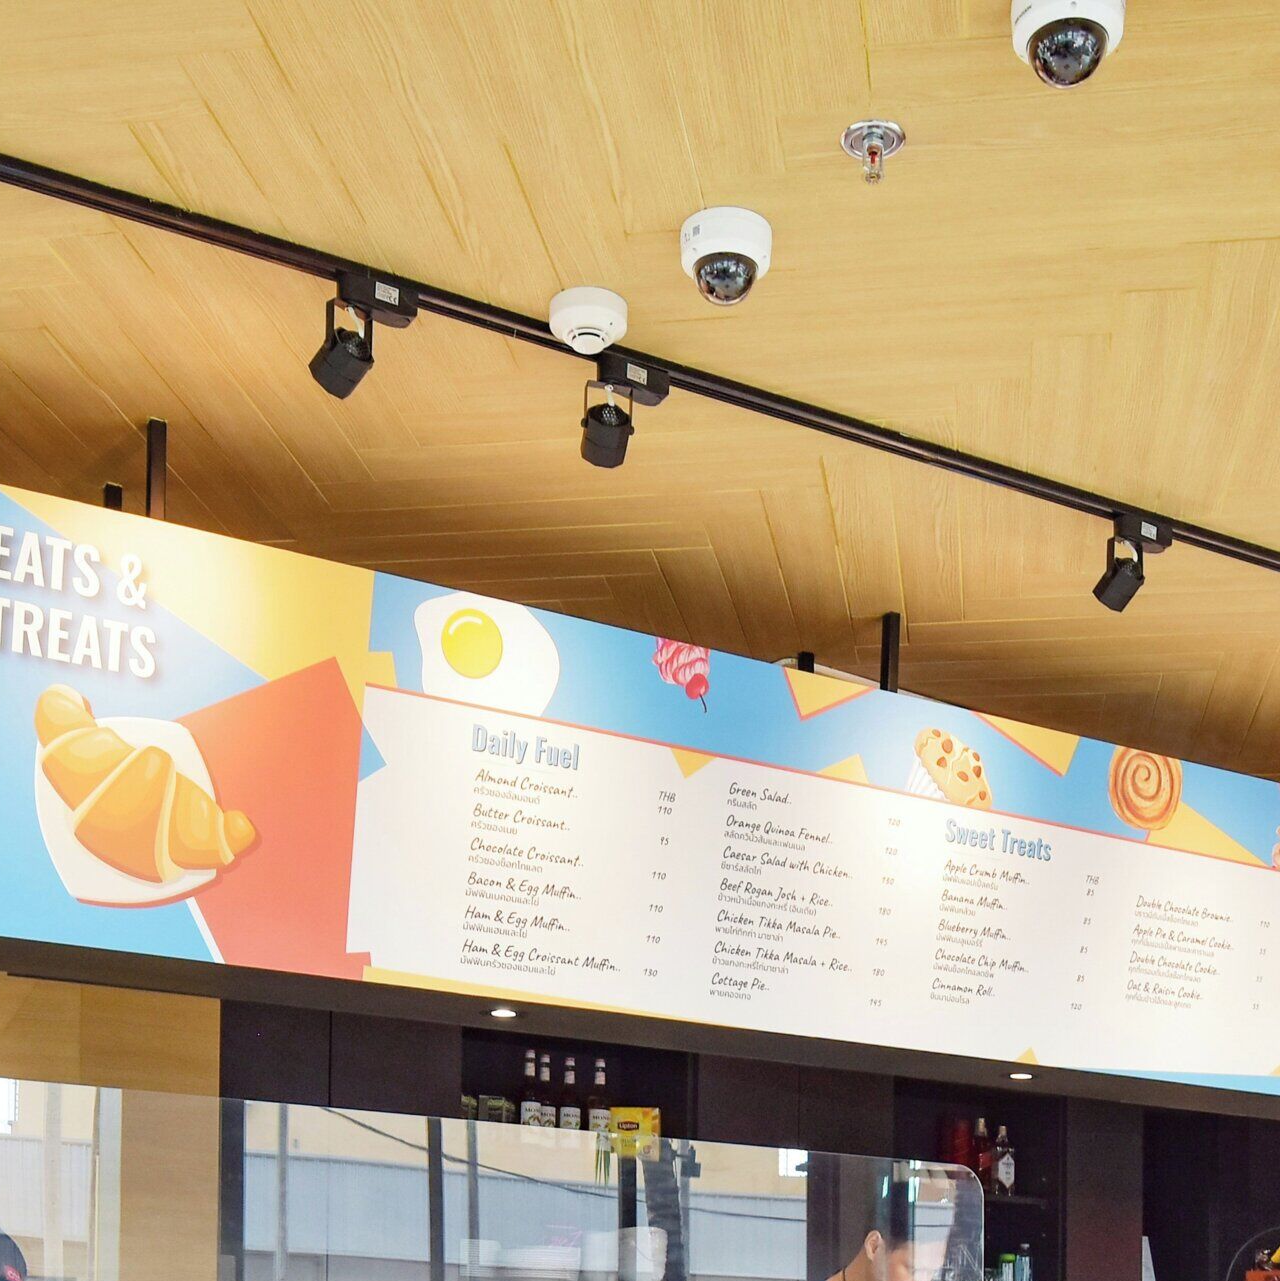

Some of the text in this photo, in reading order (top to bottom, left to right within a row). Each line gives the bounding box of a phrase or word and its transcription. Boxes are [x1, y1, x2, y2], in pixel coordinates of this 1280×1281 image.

[116, 553, 148, 609] &
[471, 724, 580, 770] Daily Fuel
[475, 769, 518, 787] Almond
[658, 790, 676, 803] THB
[729, 782, 757, 798] Green
[473, 802, 510, 820] Butter
[657, 806, 673, 815] 110
[726, 814, 761, 833] Orange
[763, 821, 796, 837] Quinoa
[470, 837, 524, 857] Chocolate
[660, 836, 669, 846] 95
[945, 818, 1052, 862] Sweet Treats
[723, 845, 757, 862] Caesar
[760, 852, 788, 868] Salad
[789, 860, 810, 872] with
[651, 871, 667, 881] 110
[944, 859, 967, 874] Apple
[969, 863, 997, 879] Crumb
[467, 871, 502, 888] Bacon
[506, 878, 516, 892] &
[518, 879, 540, 897] Egg
[719, 877, 744, 894] Beef
[744, 881, 773, 898] Rogan
[774, 887, 797, 902] Josh
[941, 889, 975, 905] Banana
[1136, 895, 1162, 910] Double
[1163, 900, 1200, 917] Chocolate
[465, 905, 491, 921] Ham
[494, 909, 503, 924] &
[507, 911, 528, 929] Egg
[648, 904, 664, 914] 110
[716, 909, 754, 926] Chicken
[758, 916, 783, 930] Tikka
[785, 920, 820, 936] Masala
[938, 918, 978, 939] Blueberry
[645, 935, 661, 945] 110
[1133, 924, 1154, 938] Apple
[1155, 927, 1167, 939] Pie
[1168, 930, 1175, 942] &
[1176, 931, 1208, 946] Caramel
[462, 938, 488, 954] Ham
[491, 943, 501, 958] &
[504, 945, 525, 962] Egg
[528, 948, 580, 967] Croissant
[714, 940, 751, 957] Chicken
[755, 947, 780, 962] Tikka
[782, 951, 817, 967] Masala
[935, 947, 976, 965] Chocolate
[977, 954, 997, 970] Chip
[1129, 950, 1156, 965] Double
[1157, 956, 1193, 972] Chocolate
[711, 972, 748, 991] Cottage
[932, 977, 973, 994] Cinnamon
[1127, 979, 1141, 991] Oat
[1143, 982, 1150, 993] &
[1152, 983, 1175, 995] Raisin
[619, 1121, 639, 1131] Lipton
